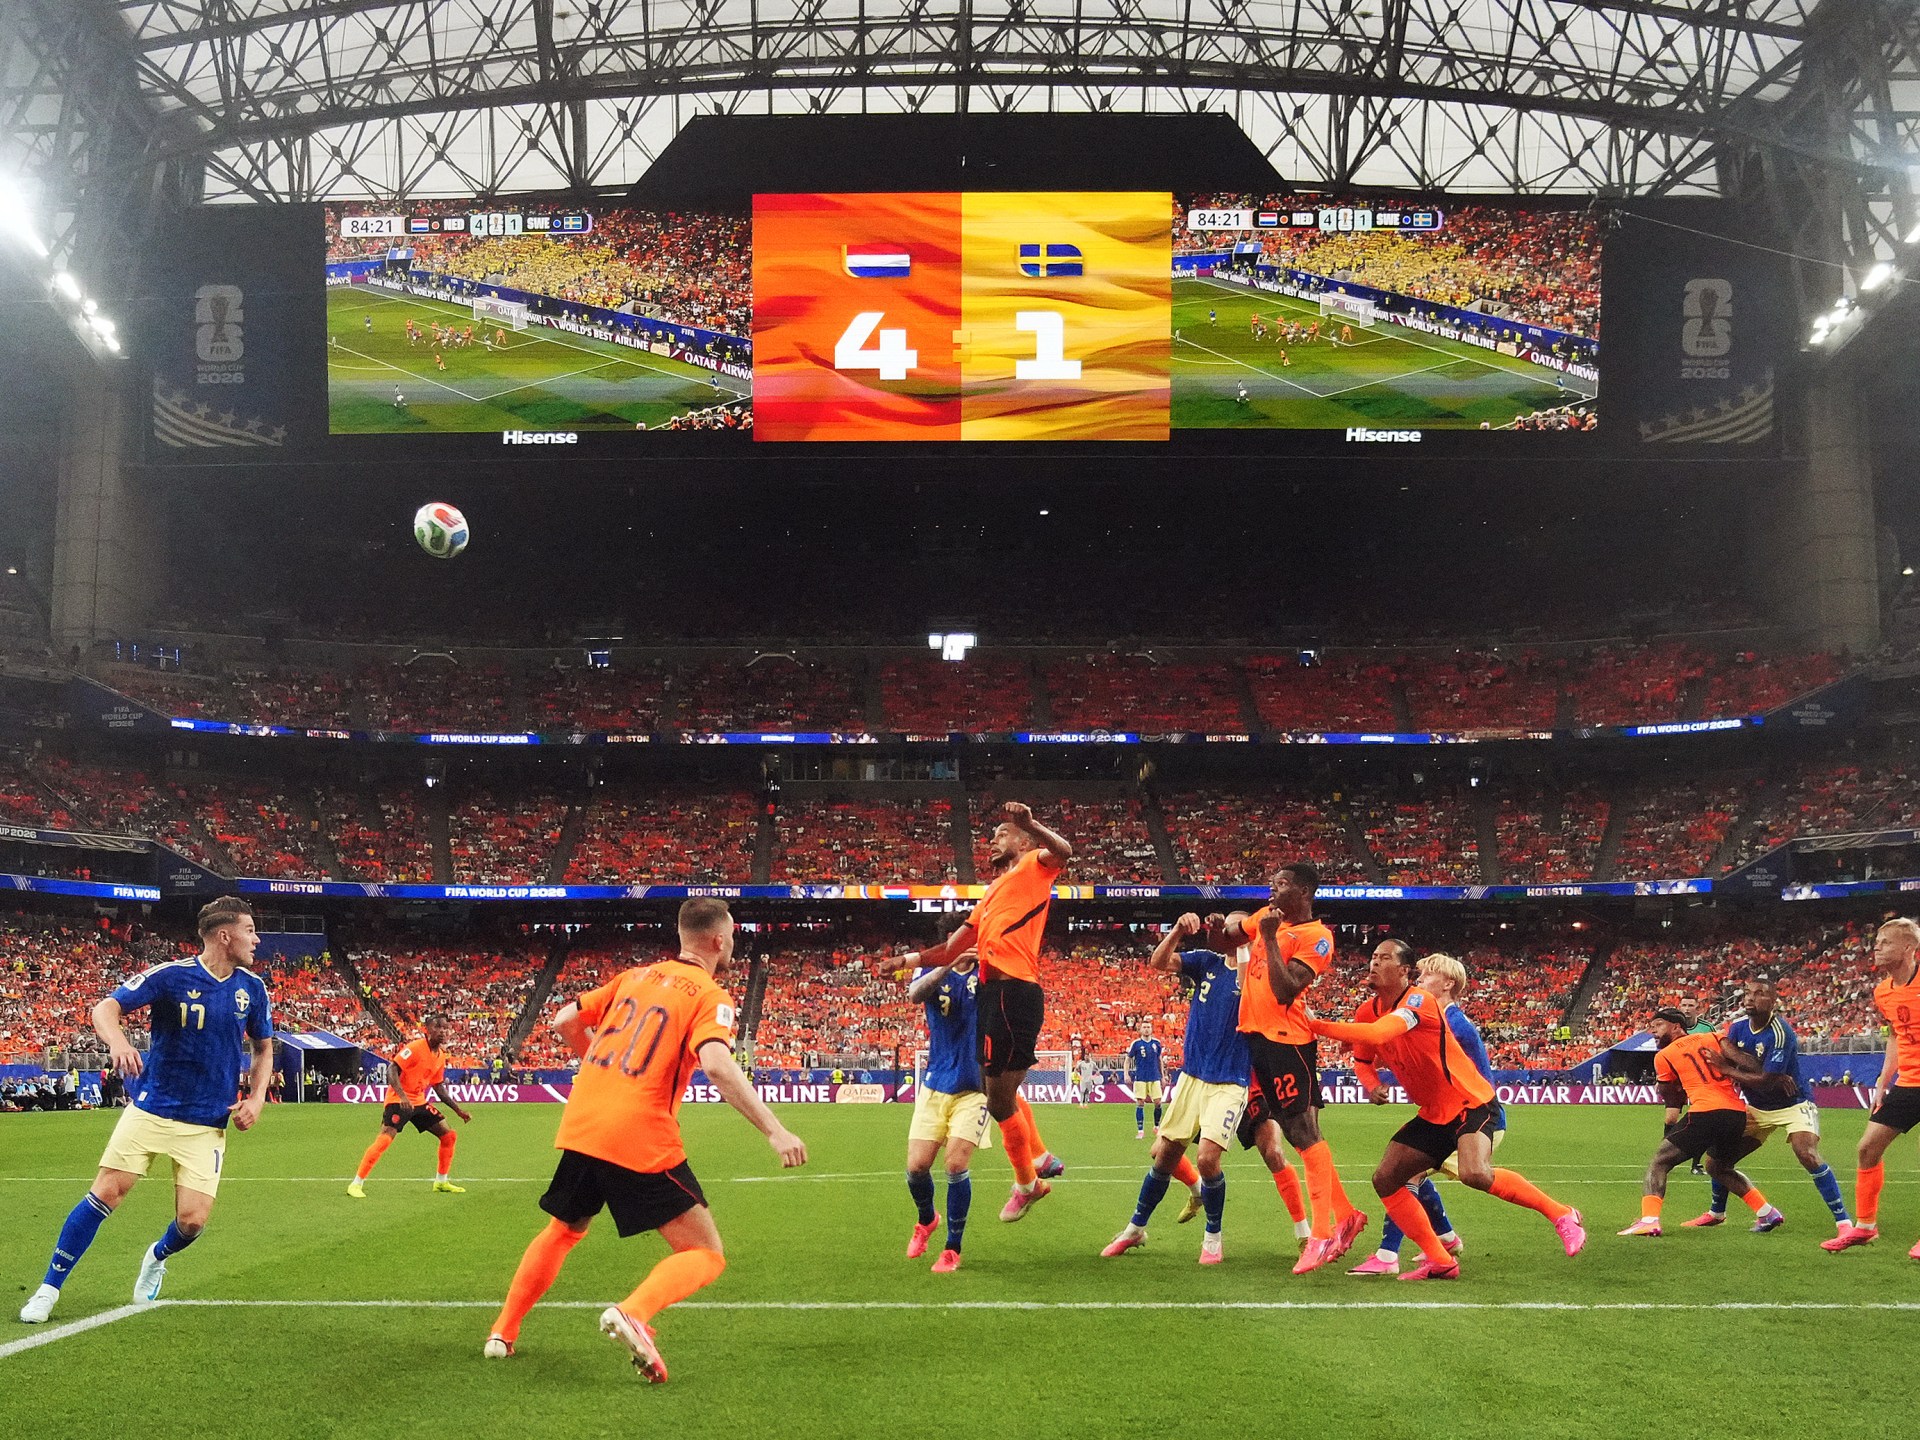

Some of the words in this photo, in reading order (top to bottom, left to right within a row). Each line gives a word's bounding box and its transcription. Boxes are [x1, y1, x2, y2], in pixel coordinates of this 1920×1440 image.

[350, 219, 393, 234] 84:21
[443, 218, 465, 231] NED
[475, 219, 483, 231] 4
[510, 219, 517, 231] 1
[526, 217, 550, 230] SWE
[1198, 213, 1241, 226] 84:21
[1292, 213, 1314, 226] NED
[1323, 214, 1332, 226] 4
[1360, 214, 1366, 226] 1
[1376, 213, 1400, 226] SWE
[558, 320, 592, 336] WORLD'S
[593, 328, 613, 342] BEST
[614, 333, 649, 351] AIRLINE
[681, 328, 695, 337] FIFA
[1405, 317, 1439, 335] WORLD'S
[1440, 326, 1460, 341] BEST
[1461, 332, 1496, 350] AIRLINE
[834, 312, 918, 380] 4
[1015, 311, 1082, 379] 1
[684, 351, 717, 370] QATAR
[1530, 350, 1563, 370] QATAR
[503, 431, 578, 444] Hisense
[1346, 428, 1421, 442] Hisense
[307, 730, 350, 739] HOSTON
[1637, 725, 1657, 734] FIFA
[1658, 723, 1689, 734] WORLD
[1691, 722, 1709, 732] CUP
[1710, 719, 1741, 729] 2026
[431, 734, 449, 743] FIFA
[450, 735, 480, 743] WORLD
[481, 735, 498, 743] CUP
[10, 829, 37, 839] 2026
[113, 887, 135, 897] FIFA
[270, 883, 323, 893] HOUSTON
[445, 887, 468, 897] FIFA
[469, 888, 507, 898] WORLD
[508, 888, 529, 897] CUP
[529, 888, 567, 897] 2026
[687, 887, 741, 897] HOUSTON
[1106, 888, 1160, 897] HOUSTON
[1315, 888, 1342, 898] ORLD
[1343, 888, 1366, 898] CUP
[1366, 888, 1403, 898] 2026
[1526, 886, 1582, 897] HOUSTON
[1198, 981, 1211, 1003] 2
[938, 994, 951, 1017] 3
[179, 1002, 205, 1030] 17
[587, 997, 669, 1076] 20
[342, 1084, 389, 1103] QAT
[426, 1084, 519, 1102] ARWAYS
[682, 1084, 722, 1103] BES
[758, 1084, 831, 1103] IRLINE
[1274, 1073, 1298, 1100] 22
[1321, 1086, 1409, 1103] AIRLE
[1497, 1085, 1570, 1104] QATAR
[1579, 1085, 1663, 1104] AIRWAY
[1223, 1110, 1235, 1130] 2
